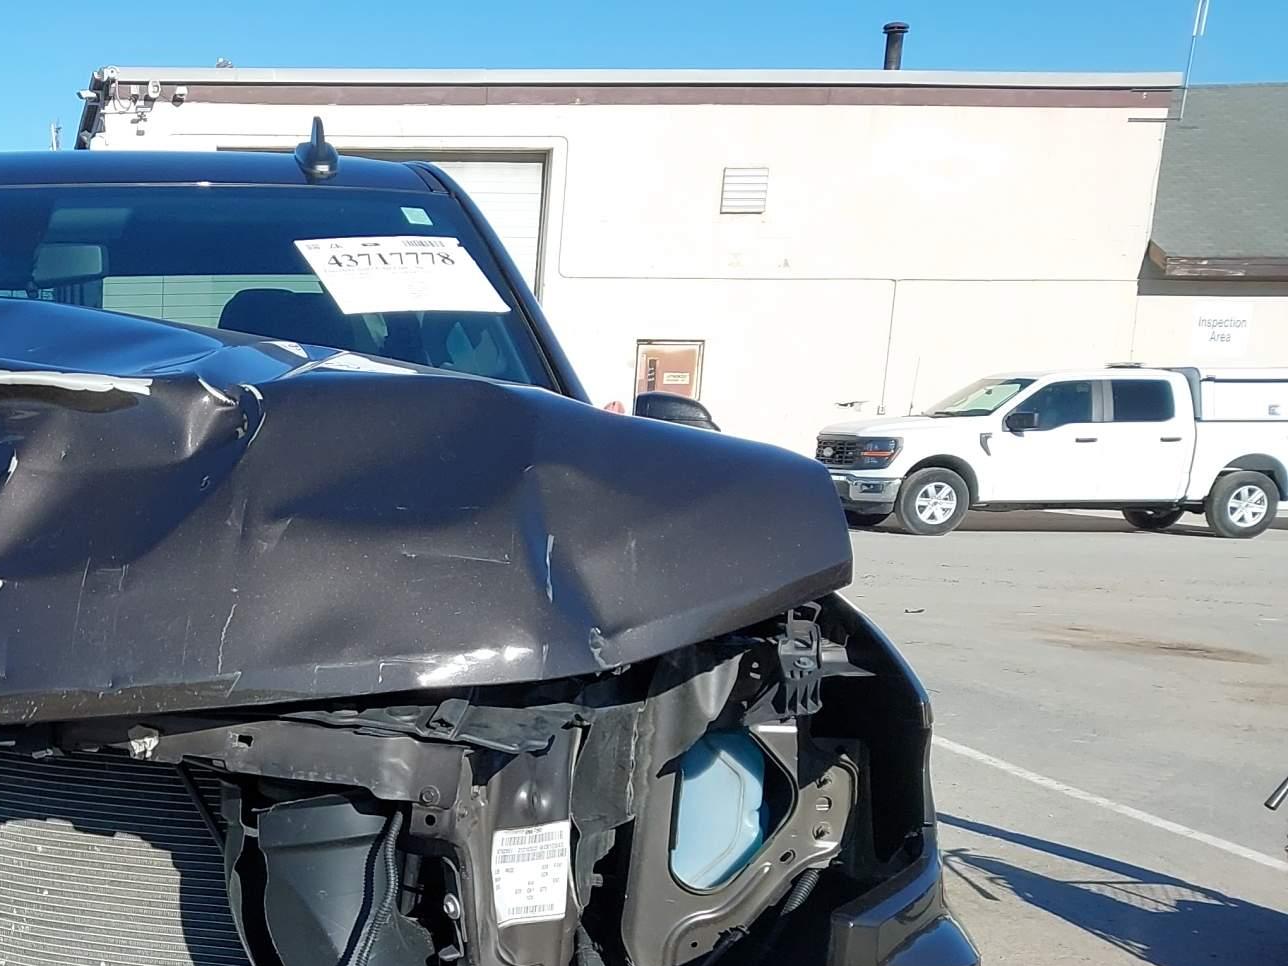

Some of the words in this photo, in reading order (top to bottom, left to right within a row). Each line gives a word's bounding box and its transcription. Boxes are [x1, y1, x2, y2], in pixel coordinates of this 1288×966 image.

[327, 252, 456, 268] 43717778
[1198, 316, 1248, 329] Inspection
[1208, 330, 1232, 342] Area
